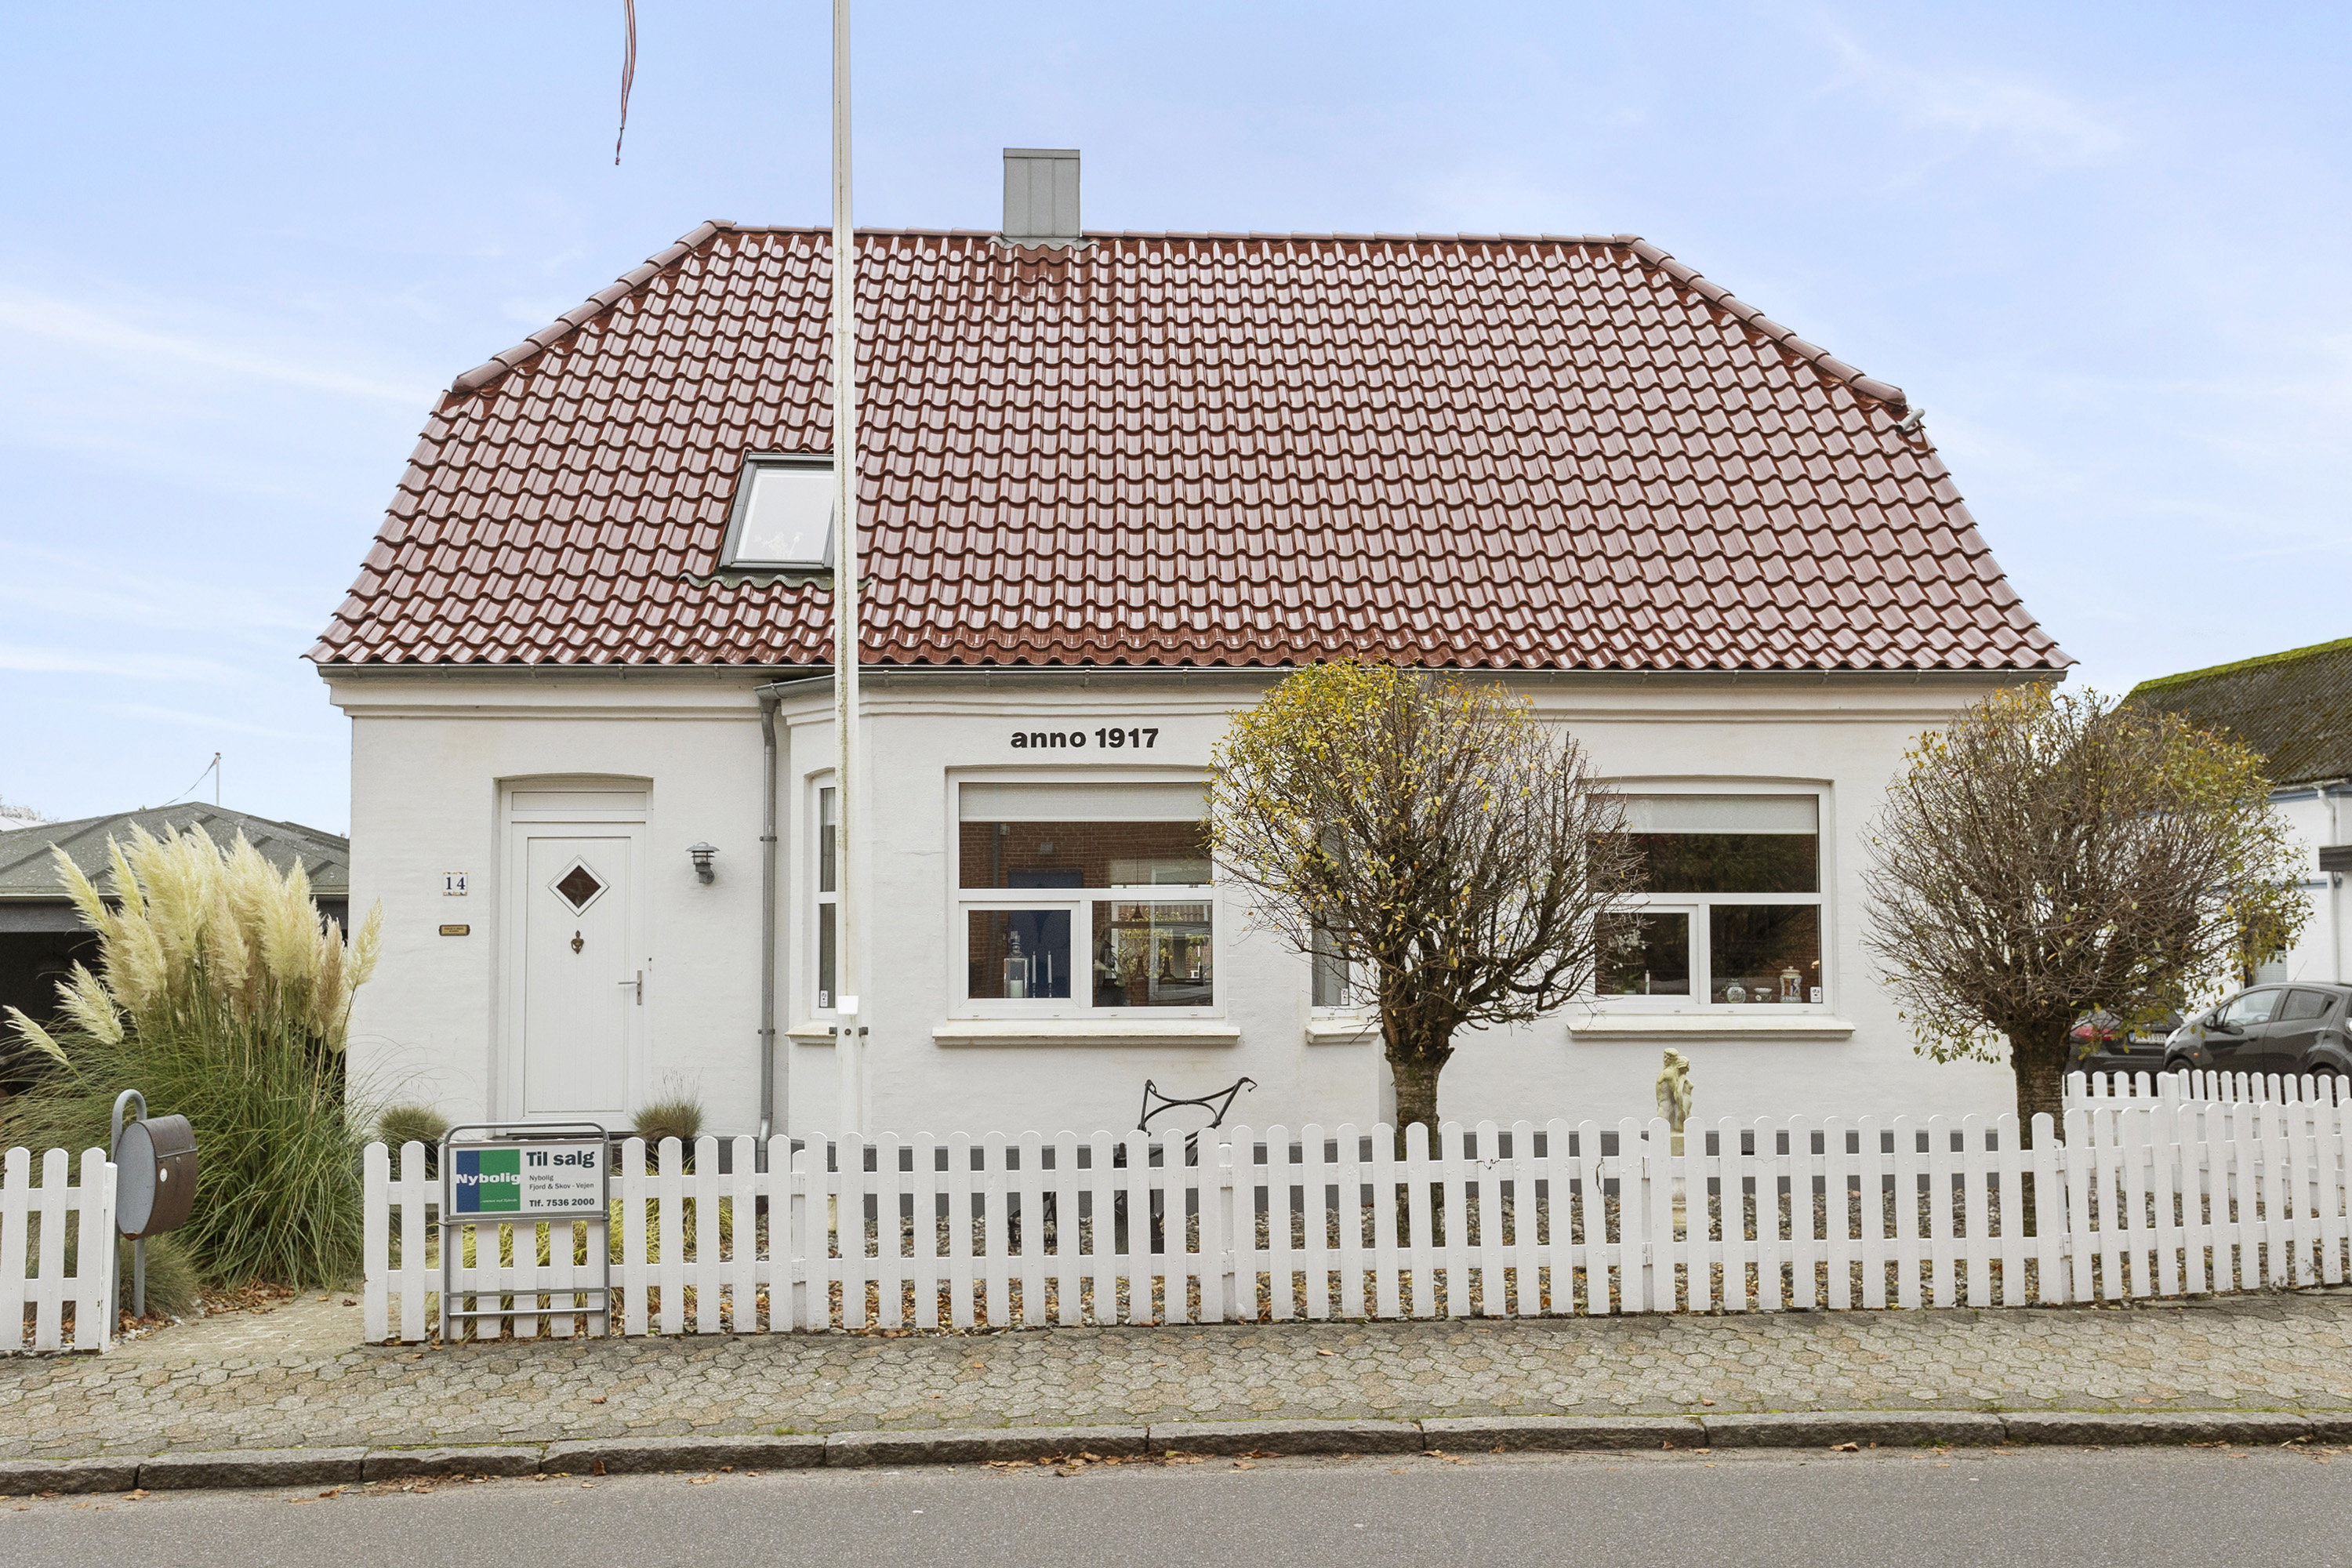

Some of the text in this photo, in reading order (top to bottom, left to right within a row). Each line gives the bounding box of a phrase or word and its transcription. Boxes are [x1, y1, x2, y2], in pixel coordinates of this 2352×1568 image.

[1011, 728, 1159, 749] anno 1917
[445, 877, 466, 890] 14
[526, 1150, 595, 1168] Til salg
[456, 1172, 521, 1185] Nybolig
[528, 1199, 544, 1207] Tlf.
